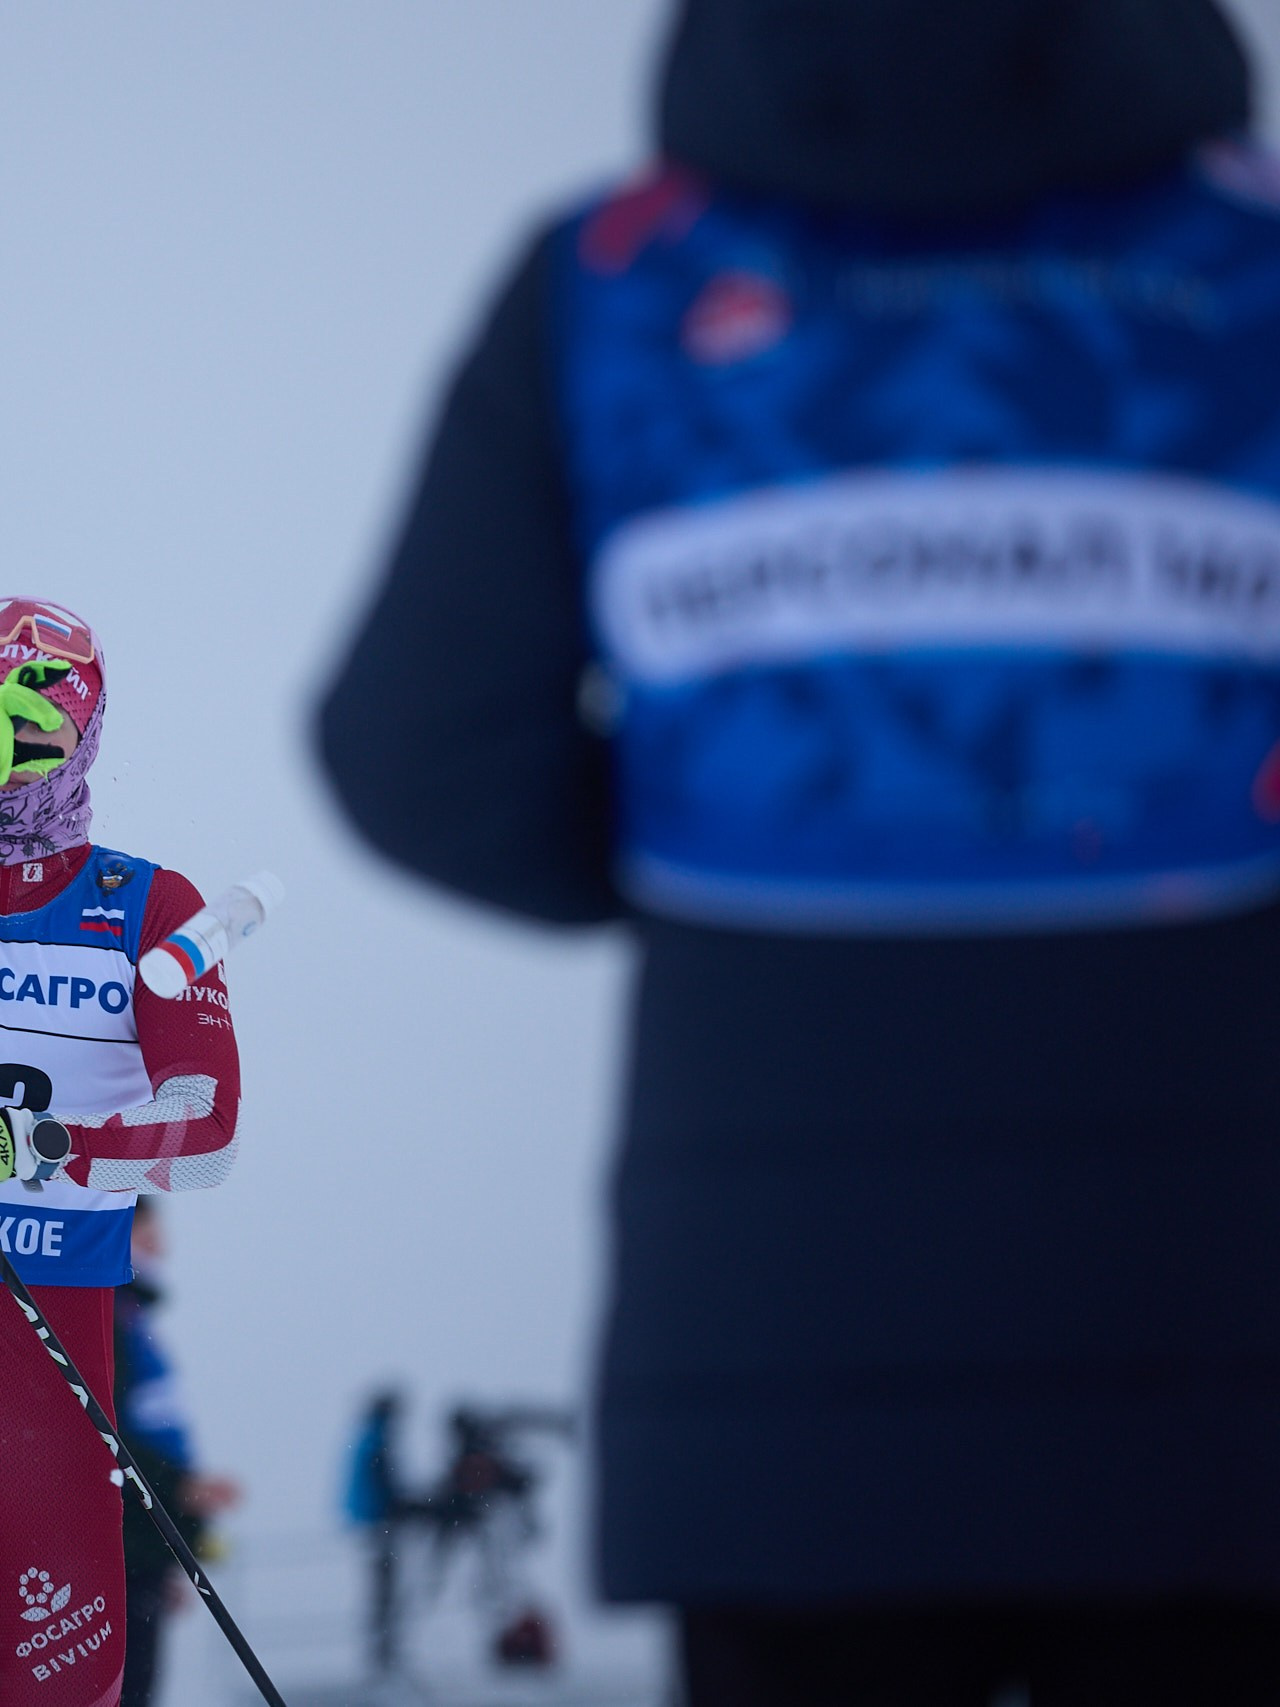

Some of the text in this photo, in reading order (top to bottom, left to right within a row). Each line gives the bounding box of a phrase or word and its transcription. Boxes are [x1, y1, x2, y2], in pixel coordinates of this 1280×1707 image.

[0, 645, 89, 700] ЛУКЙЛ
[15, 1596, 106, 1658] ФОСАГРО
[31, 1620, 112, 1682] BIVIUM
